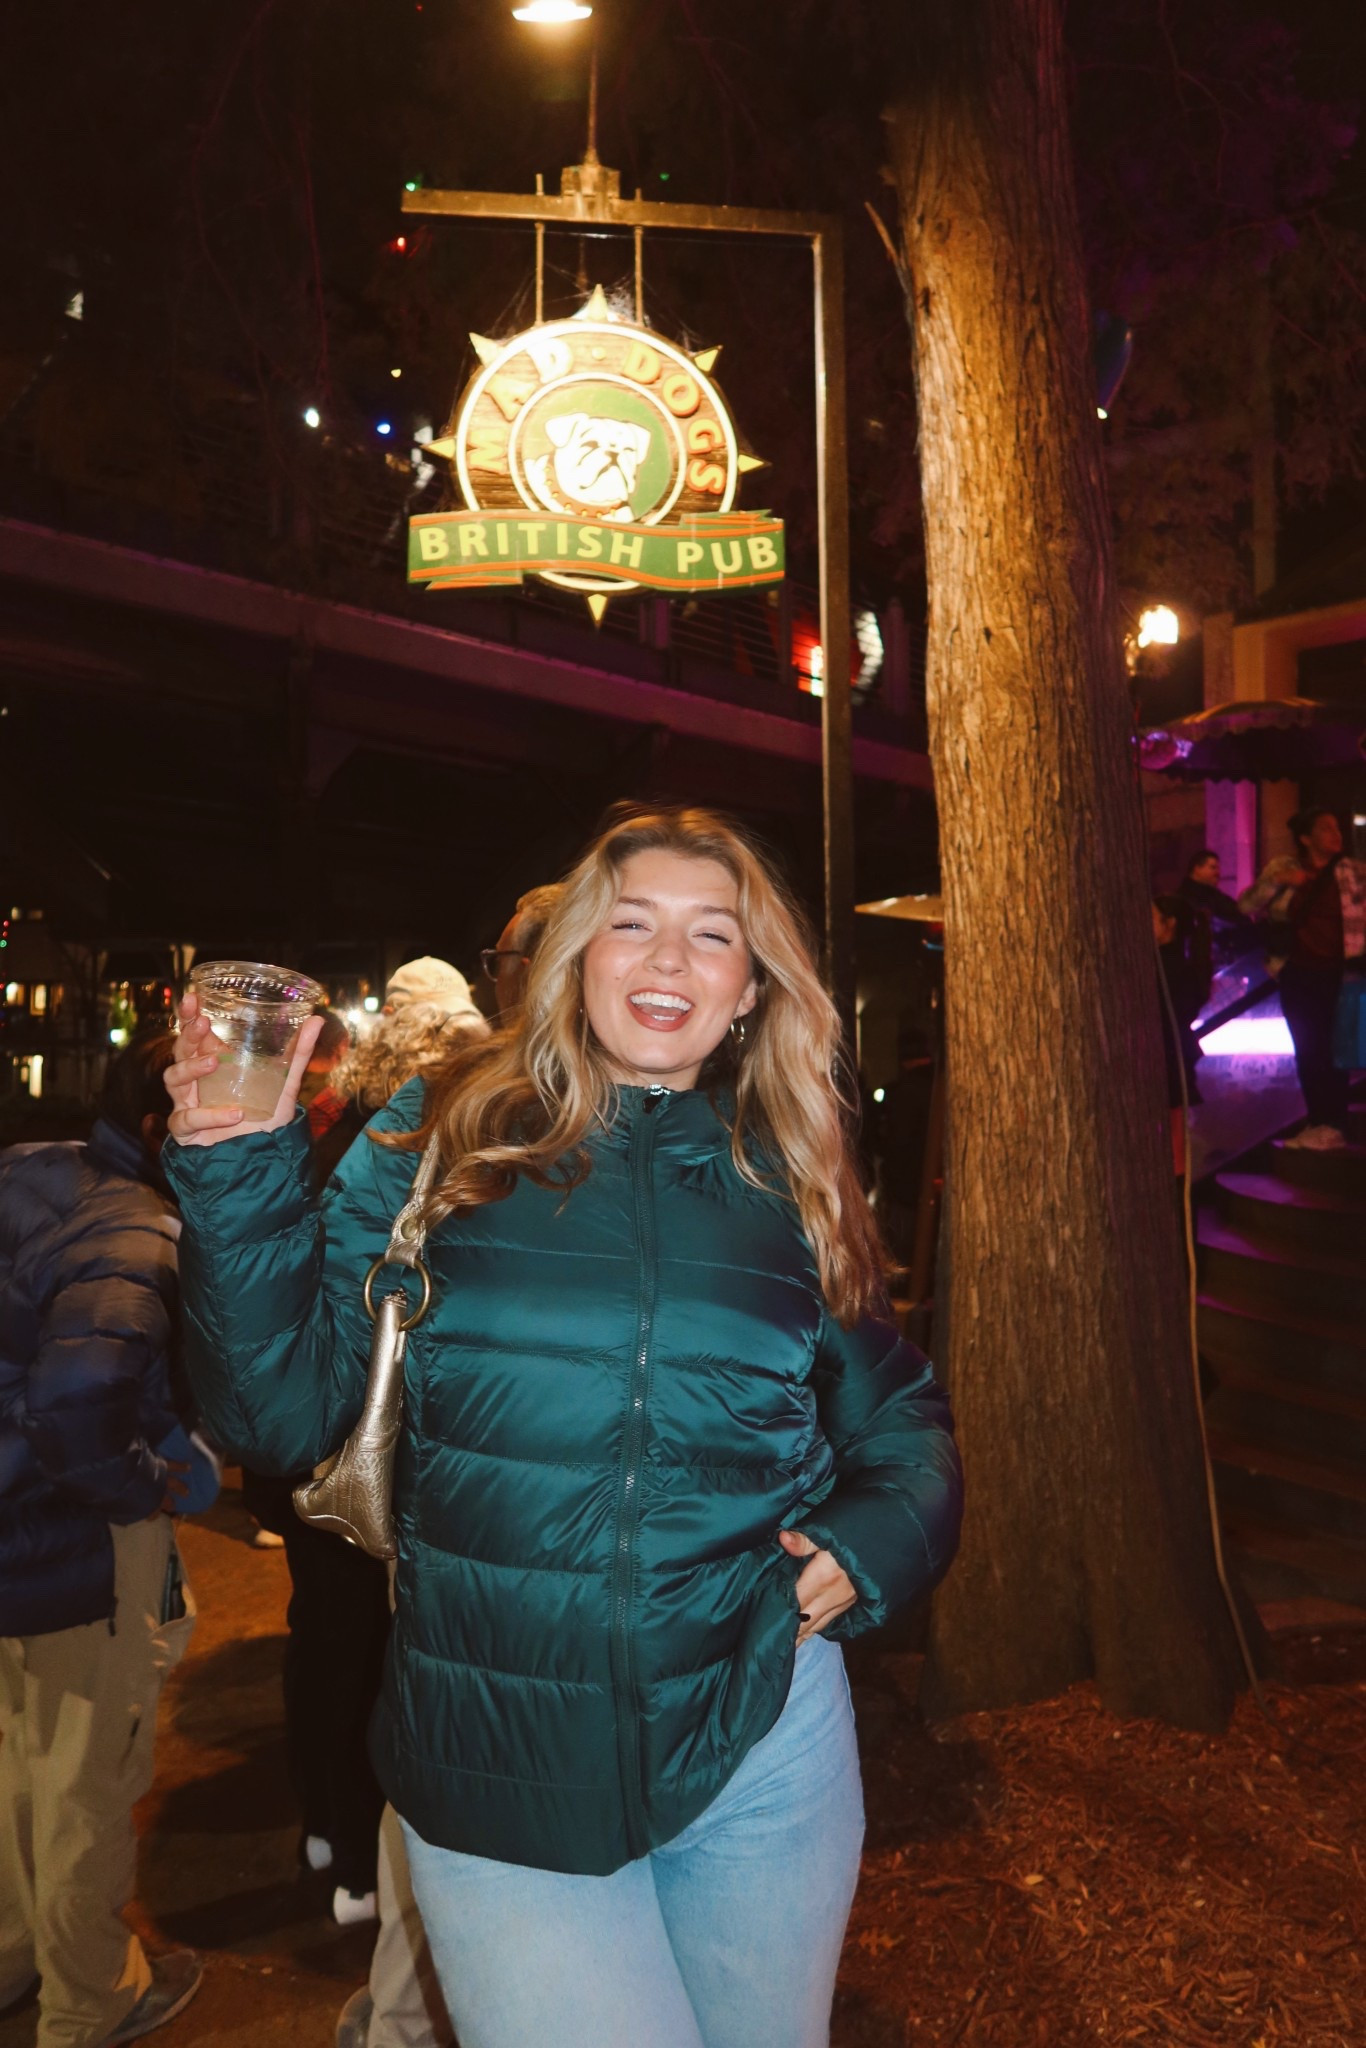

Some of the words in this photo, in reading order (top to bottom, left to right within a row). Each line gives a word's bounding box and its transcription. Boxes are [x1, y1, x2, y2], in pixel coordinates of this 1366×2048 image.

[469, 337, 573, 475] MAD
[620, 341, 728, 496] DOGS
[418, 522, 645, 569] BRITISH
[676, 536, 779, 574] PUB
